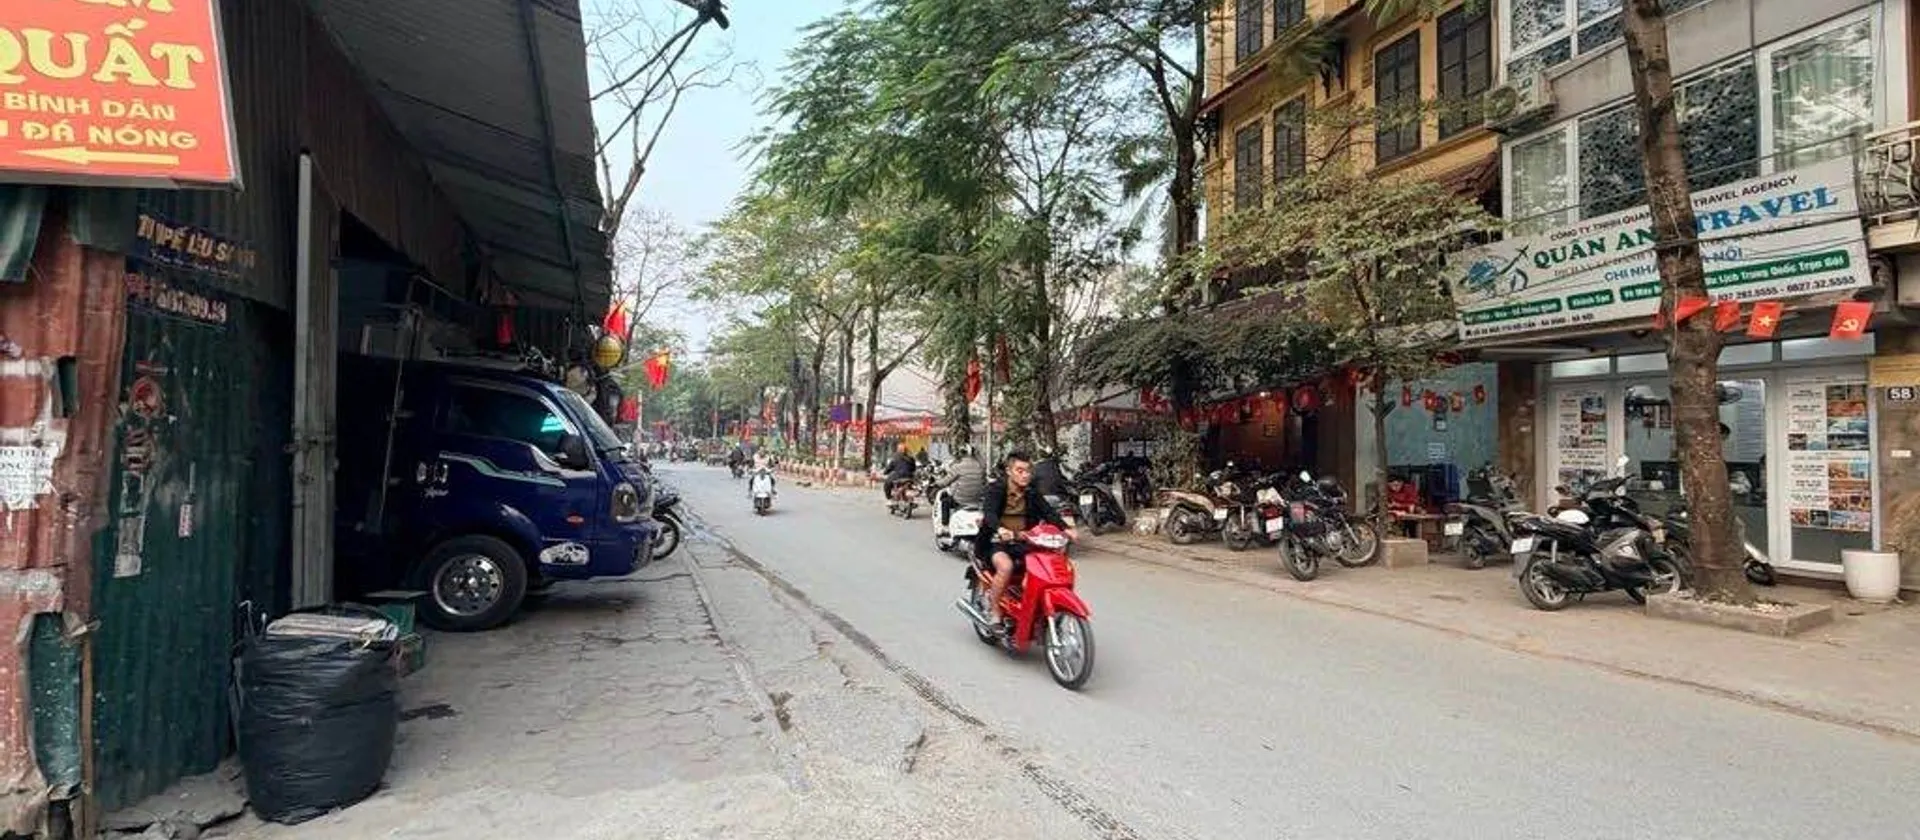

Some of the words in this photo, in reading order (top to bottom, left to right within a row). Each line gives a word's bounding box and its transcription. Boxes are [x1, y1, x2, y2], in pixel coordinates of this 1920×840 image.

[4, 90, 90, 115] BÌNH
[102, 98, 176, 121] DÂN
[22, 119, 76, 143] ĐÁ
[88, 124, 198, 149] NÓNG
[1694, 190, 1738, 208] TRAVEL
[1742, 175, 1799, 197] AGENCY
[1696, 184, 1838, 233] TRAVEL
[1533, 236, 1606, 270] QUÂN
[1890, 388, 1911, 399] 58
